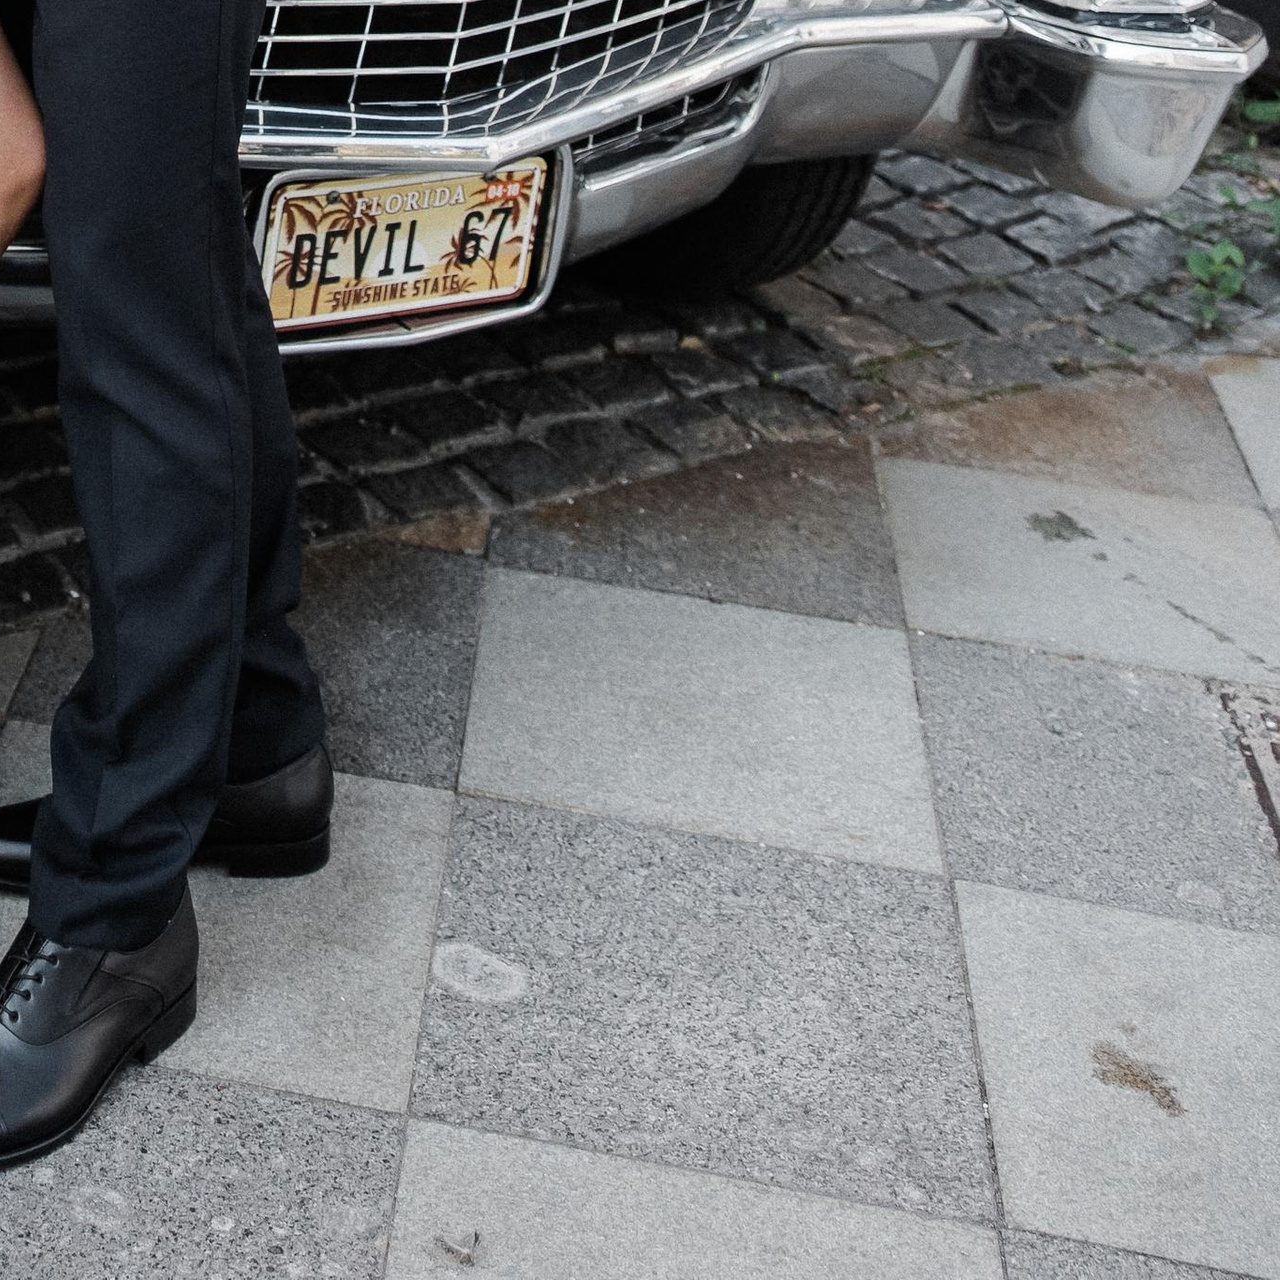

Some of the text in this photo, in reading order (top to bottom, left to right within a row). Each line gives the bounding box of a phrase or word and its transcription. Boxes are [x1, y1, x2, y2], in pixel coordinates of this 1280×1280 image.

[354, 185, 467, 217] FLORIDA
[289, 207, 513, 289] DEVIL 67
[332, 274, 459, 308] SUNSHINE STATE
